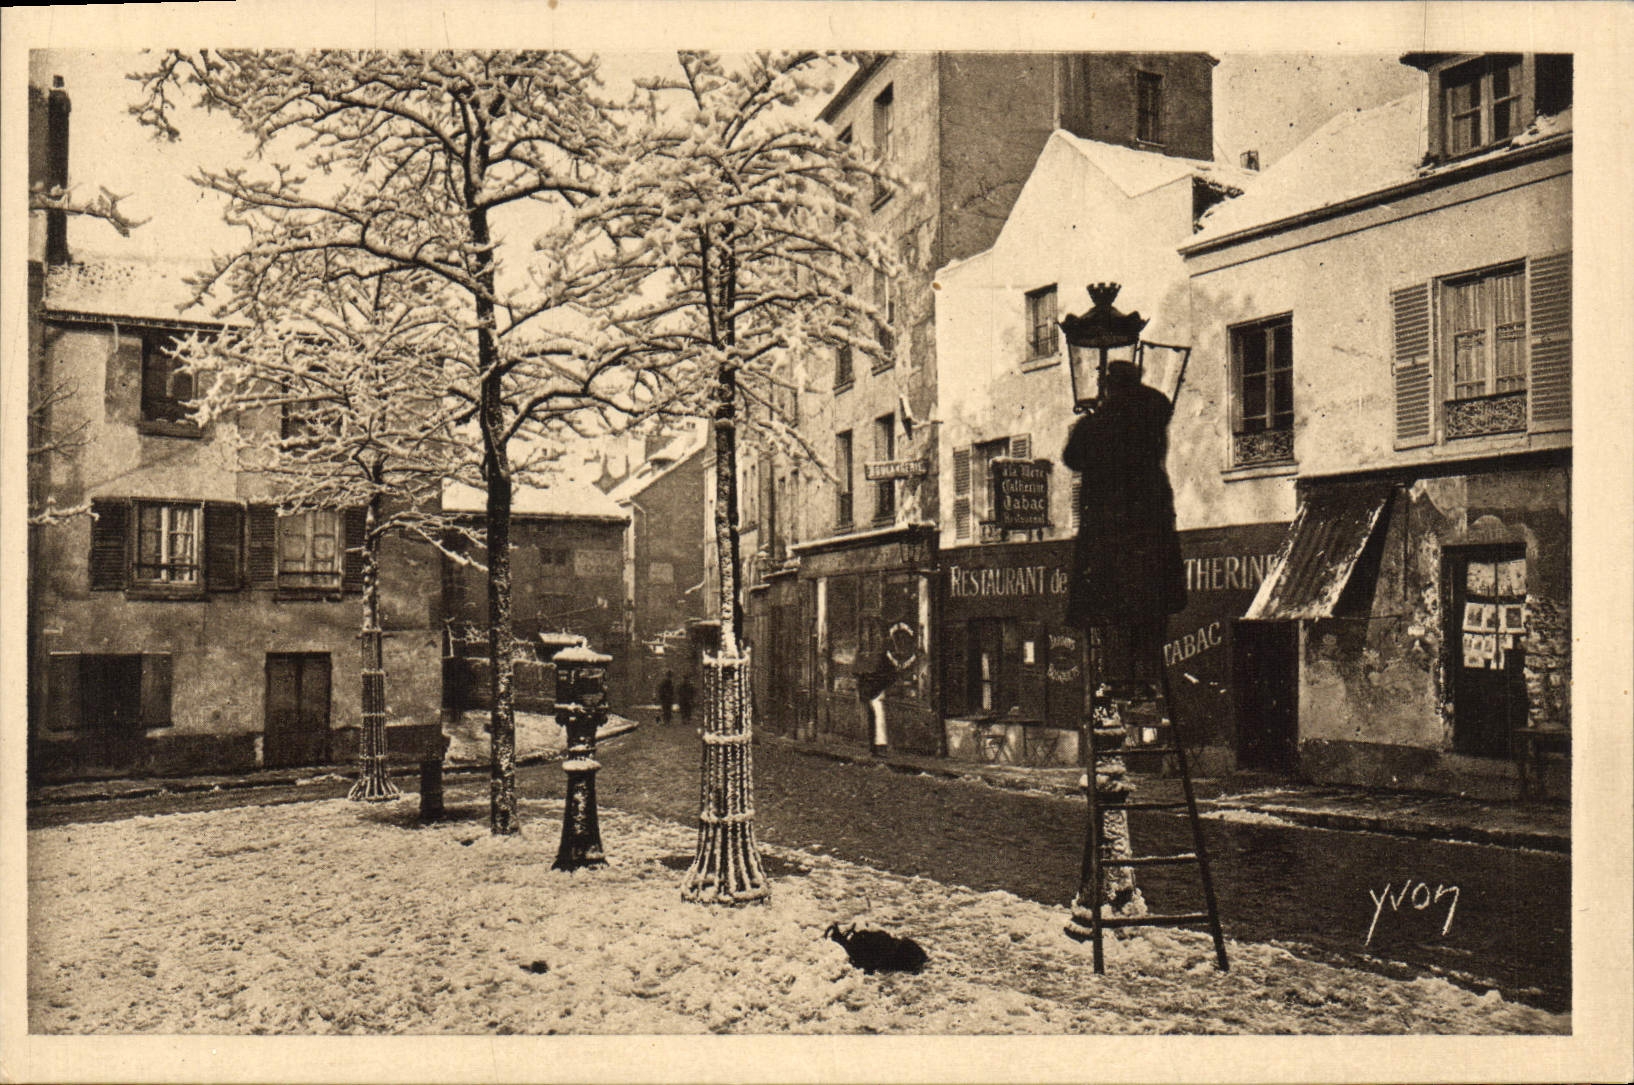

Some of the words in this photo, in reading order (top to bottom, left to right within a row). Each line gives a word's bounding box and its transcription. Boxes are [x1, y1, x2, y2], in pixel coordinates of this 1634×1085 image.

[1003, 495, 1046, 511] Tabac
[1051, 569, 1068, 594] de
[1163, 622, 1222, 667] TABAC
